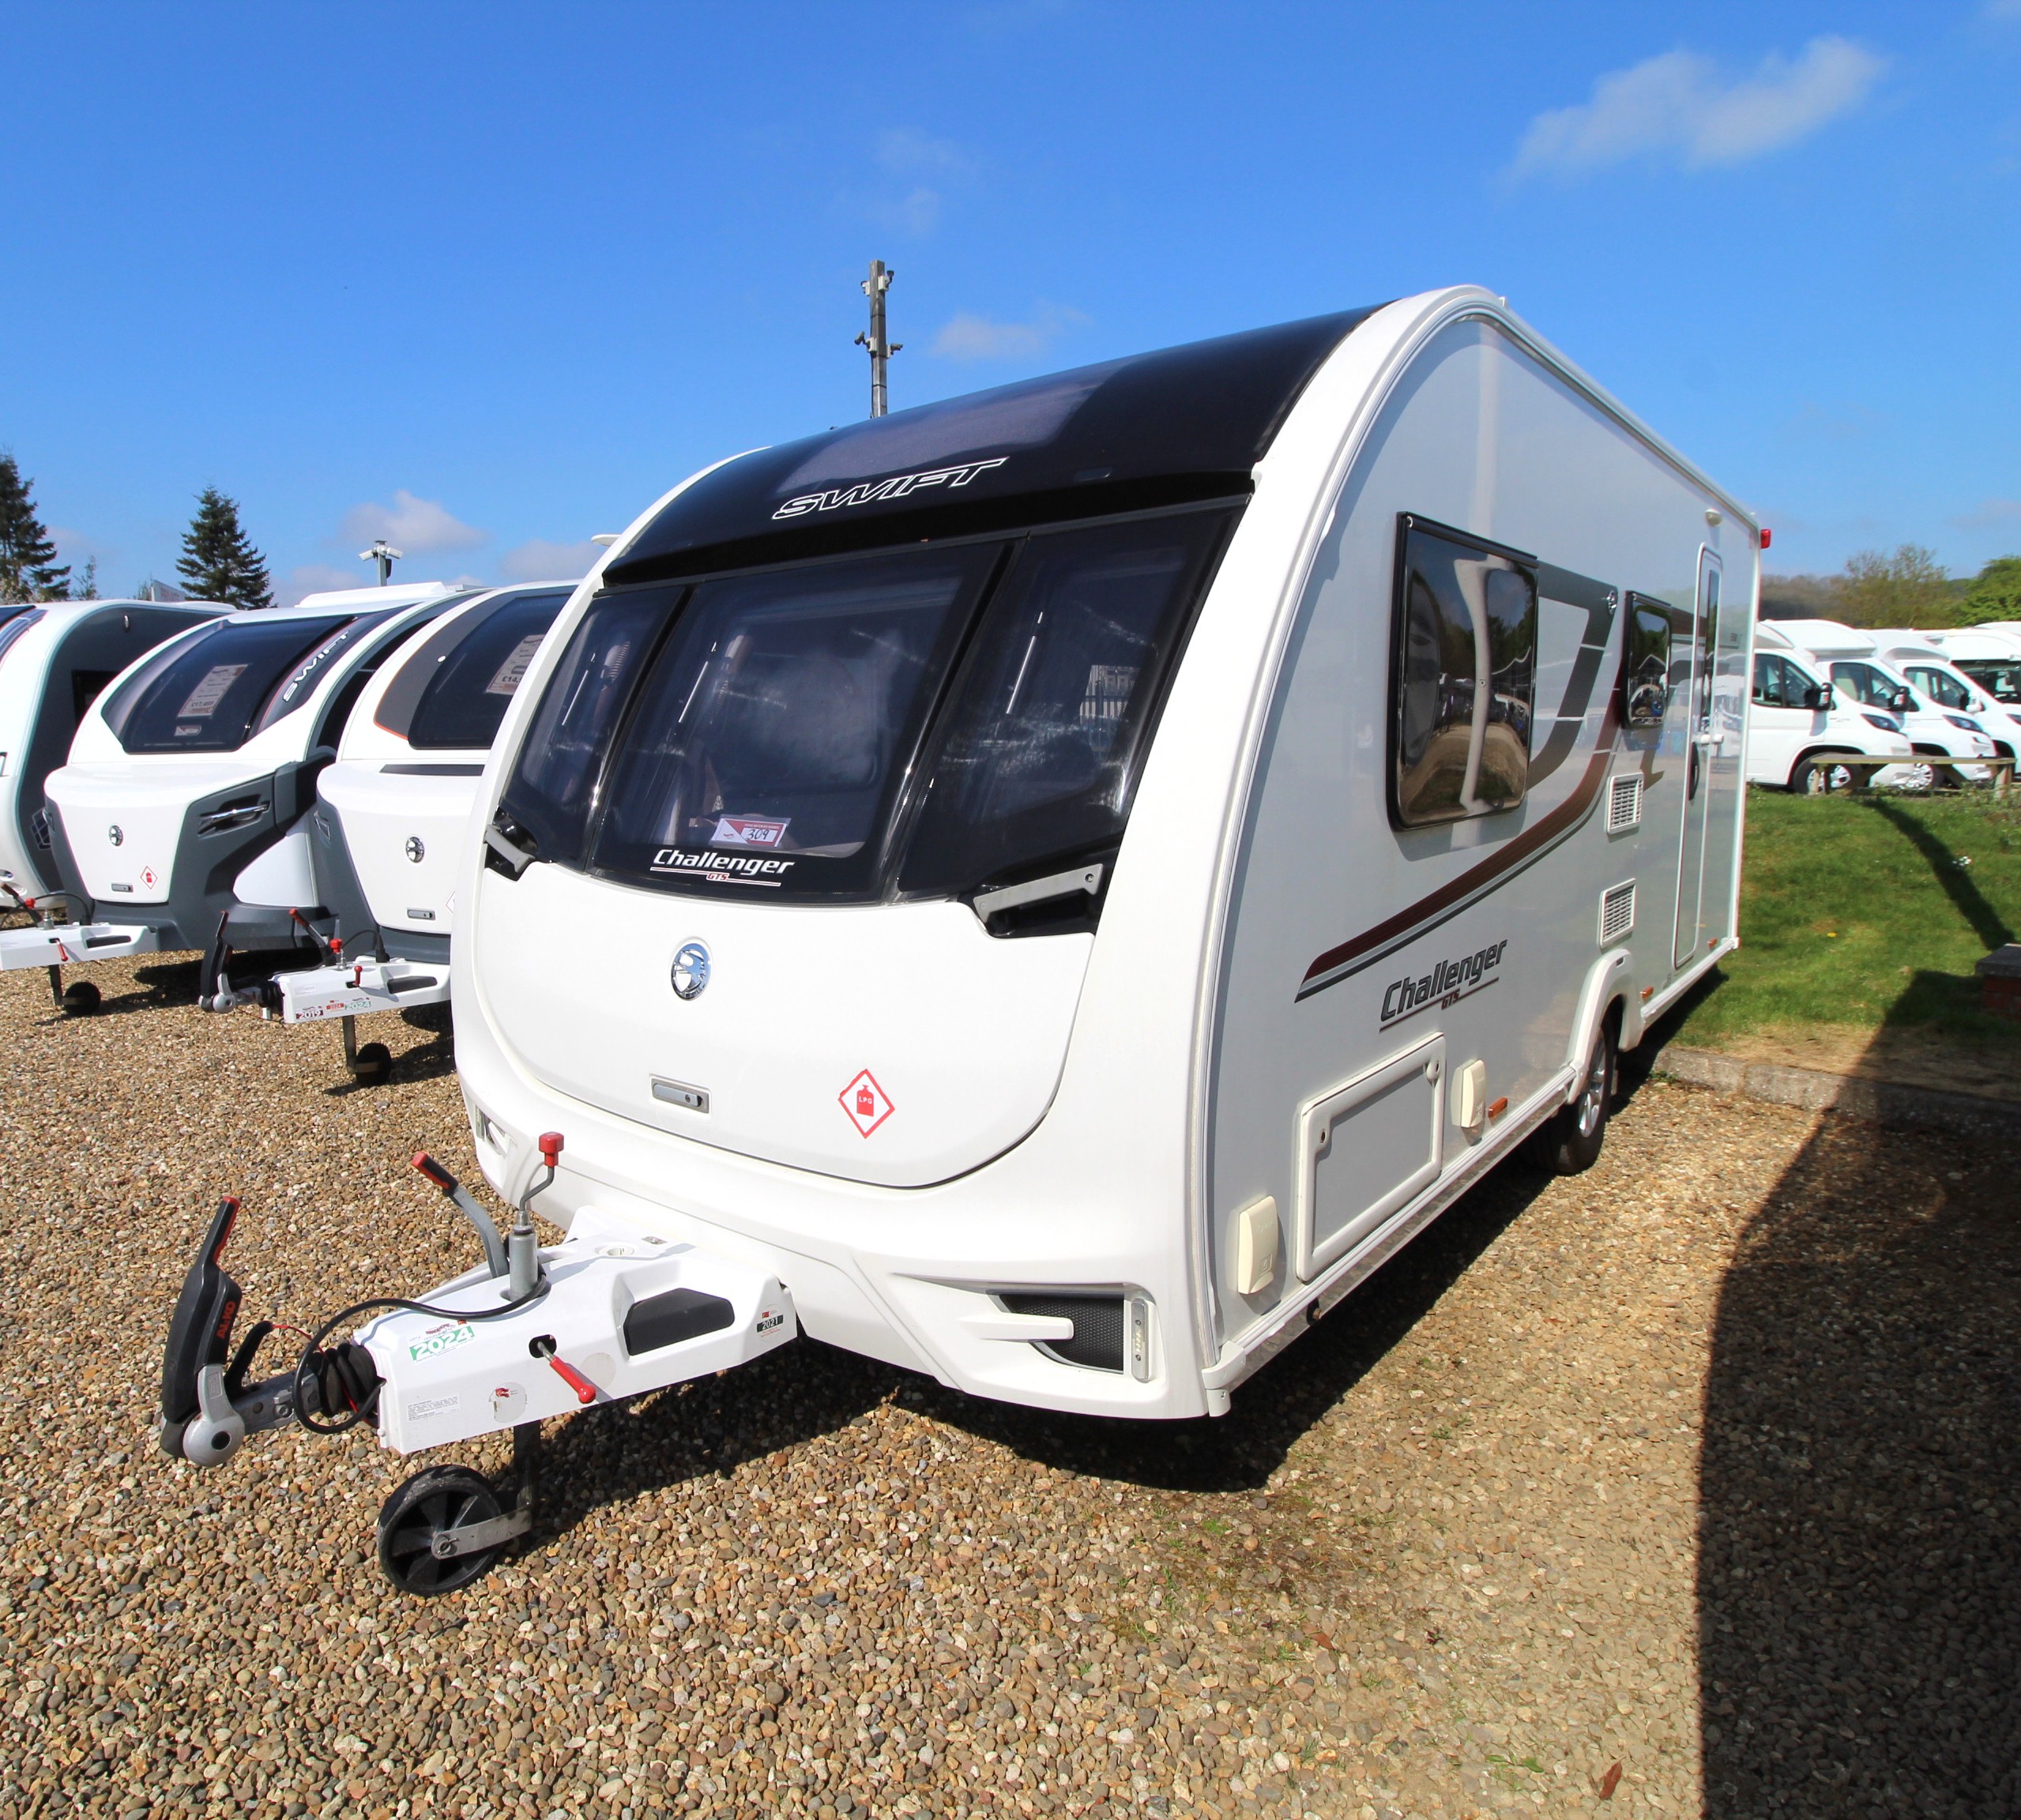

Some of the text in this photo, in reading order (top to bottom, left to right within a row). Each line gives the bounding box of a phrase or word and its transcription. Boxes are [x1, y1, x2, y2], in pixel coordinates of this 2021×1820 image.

[771, 457, 1010, 520] SWIFT
[282, 630, 350, 702] SWIFT
[747, 829, 770, 840] 309
[653, 848, 795, 875] Challenger
[707, 872, 729, 881] GTS
[1380, 939, 1507, 1022] Challenger
[1441, 987, 1460, 1010] GTS
[299, 1010, 322, 1019] 2019
[762, 1317, 778, 1330] 2021
[412, 1326, 474, 1361] 2024
